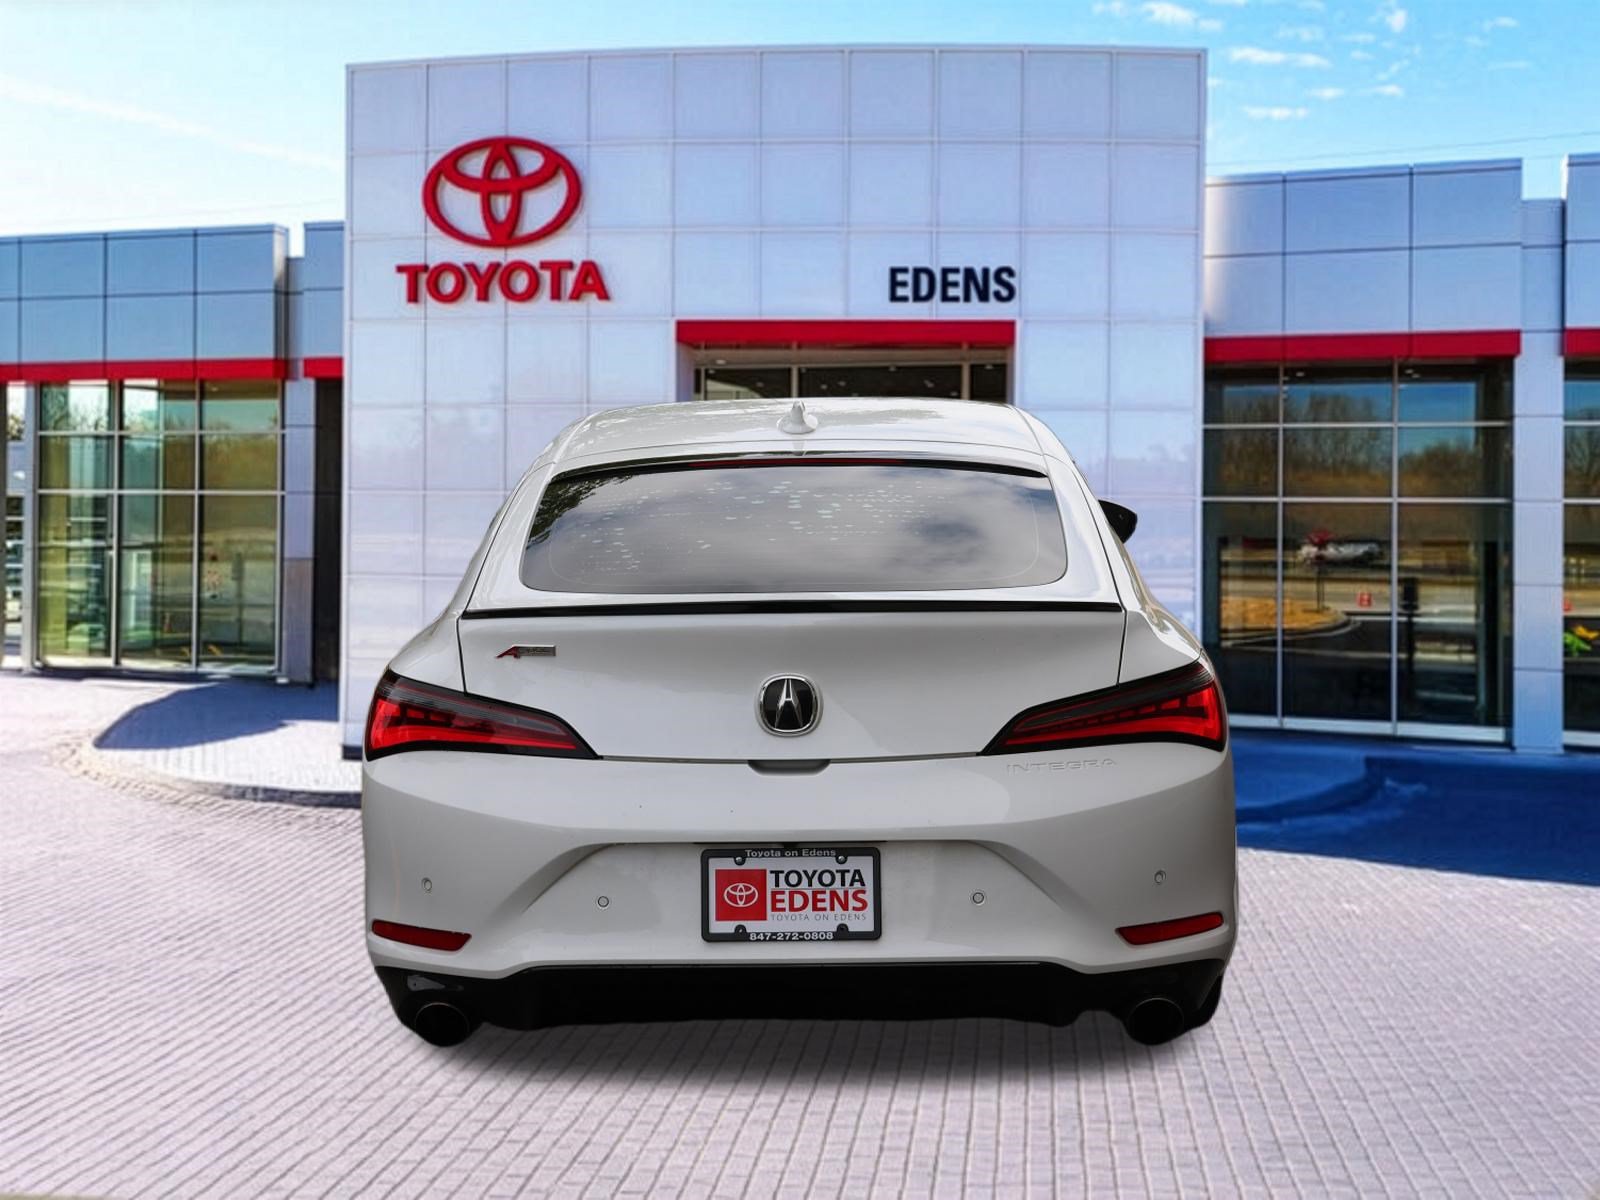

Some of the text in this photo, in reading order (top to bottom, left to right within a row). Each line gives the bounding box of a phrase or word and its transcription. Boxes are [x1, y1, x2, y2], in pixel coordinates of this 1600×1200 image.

[396, 259, 611, 304] TOYOTA
[889, 266, 1017, 303] EDENS
[1007, 757, 1119, 776] INTEGRA
[745, 849, 781, 858] Toyota
[802, 848, 837, 857] Edens
[769, 869, 867, 888] TOYOTA
[770, 889, 869, 913] EDENS
[771, 913, 867, 921] TOYOTA ON EDENS
[749, 931, 834, 941] 847-272-0808
